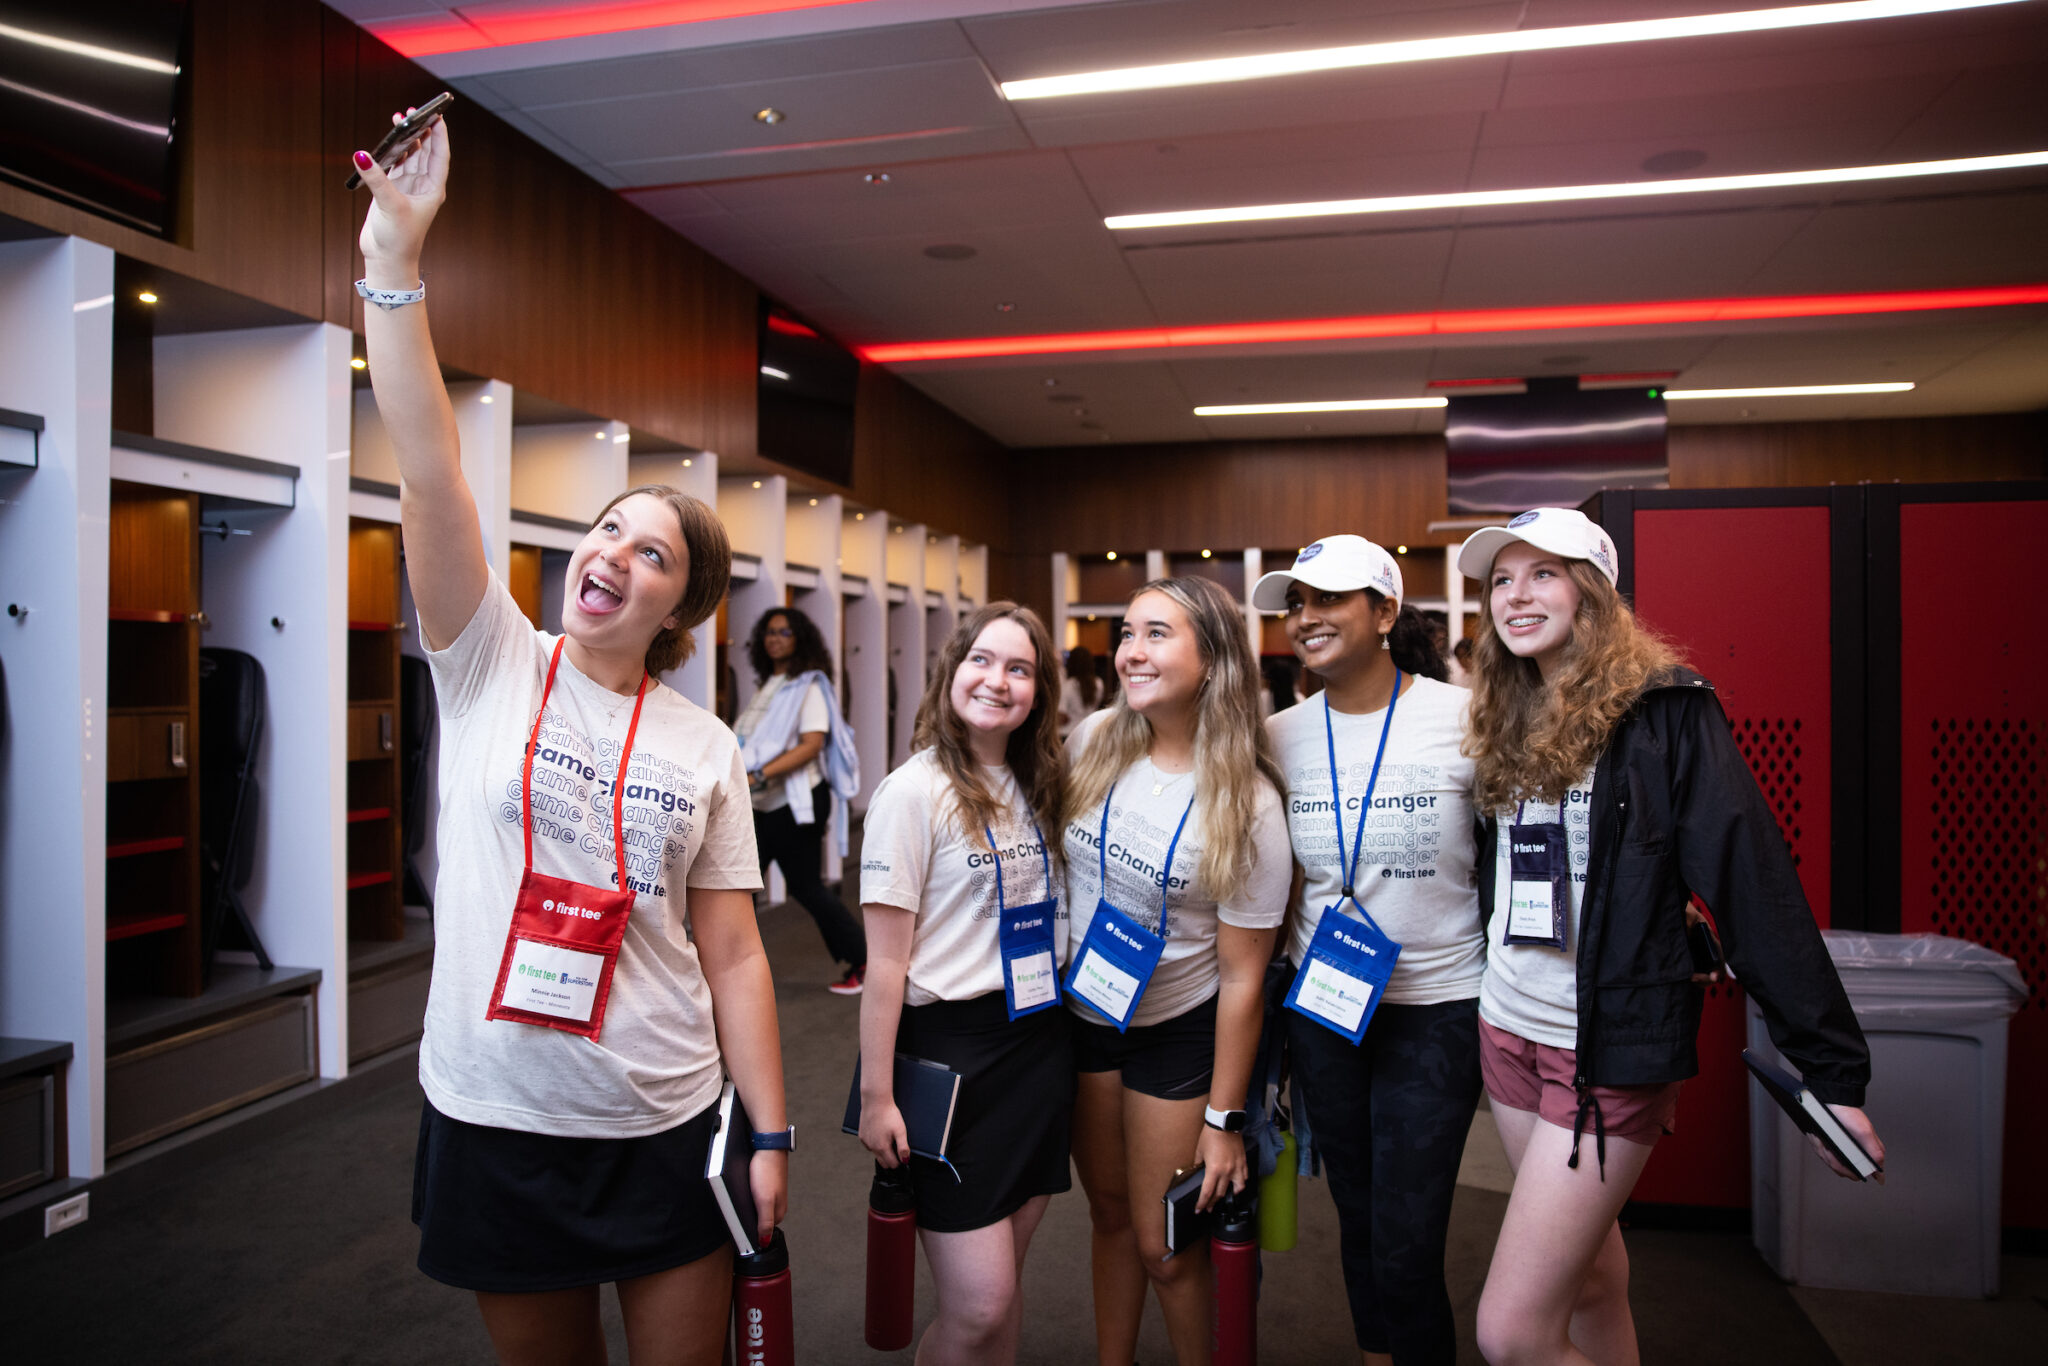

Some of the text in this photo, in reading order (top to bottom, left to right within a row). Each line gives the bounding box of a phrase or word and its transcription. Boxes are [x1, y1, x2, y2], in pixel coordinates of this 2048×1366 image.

[598, 737, 695, 780] Changer
[525, 741, 696, 817] Game Changer
[596, 758, 697, 798] Changer
[1350, 762, 1440, 780] Changer
[1347, 779, 1439, 796] Changer
[590, 792, 694, 838] Changer
[1291, 795, 1438, 814] Game Changer
[500, 802, 577, 844] Game
[507, 779, 687, 859] Game Changer
[1345, 813, 1440, 832] Changer
[1345, 831, 1441, 850] Changer
[1067, 822, 1102, 850] ame
[1108, 843, 1190, 891] Changer
[1394, 869, 1436, 879] first tee
[626, 876, 668, 897] first te
[556, 901, 602, 920] first tee
[1113, 927, 1130, 943] first
[1128, 937, 1143, 951] tee
[1342, 934, 1377, 957] first tee
[527, 965, 557, 982] first tee
[567, 978, 594, 987] SUPERSTORE
[747, 1307, 765, 1348] tee
